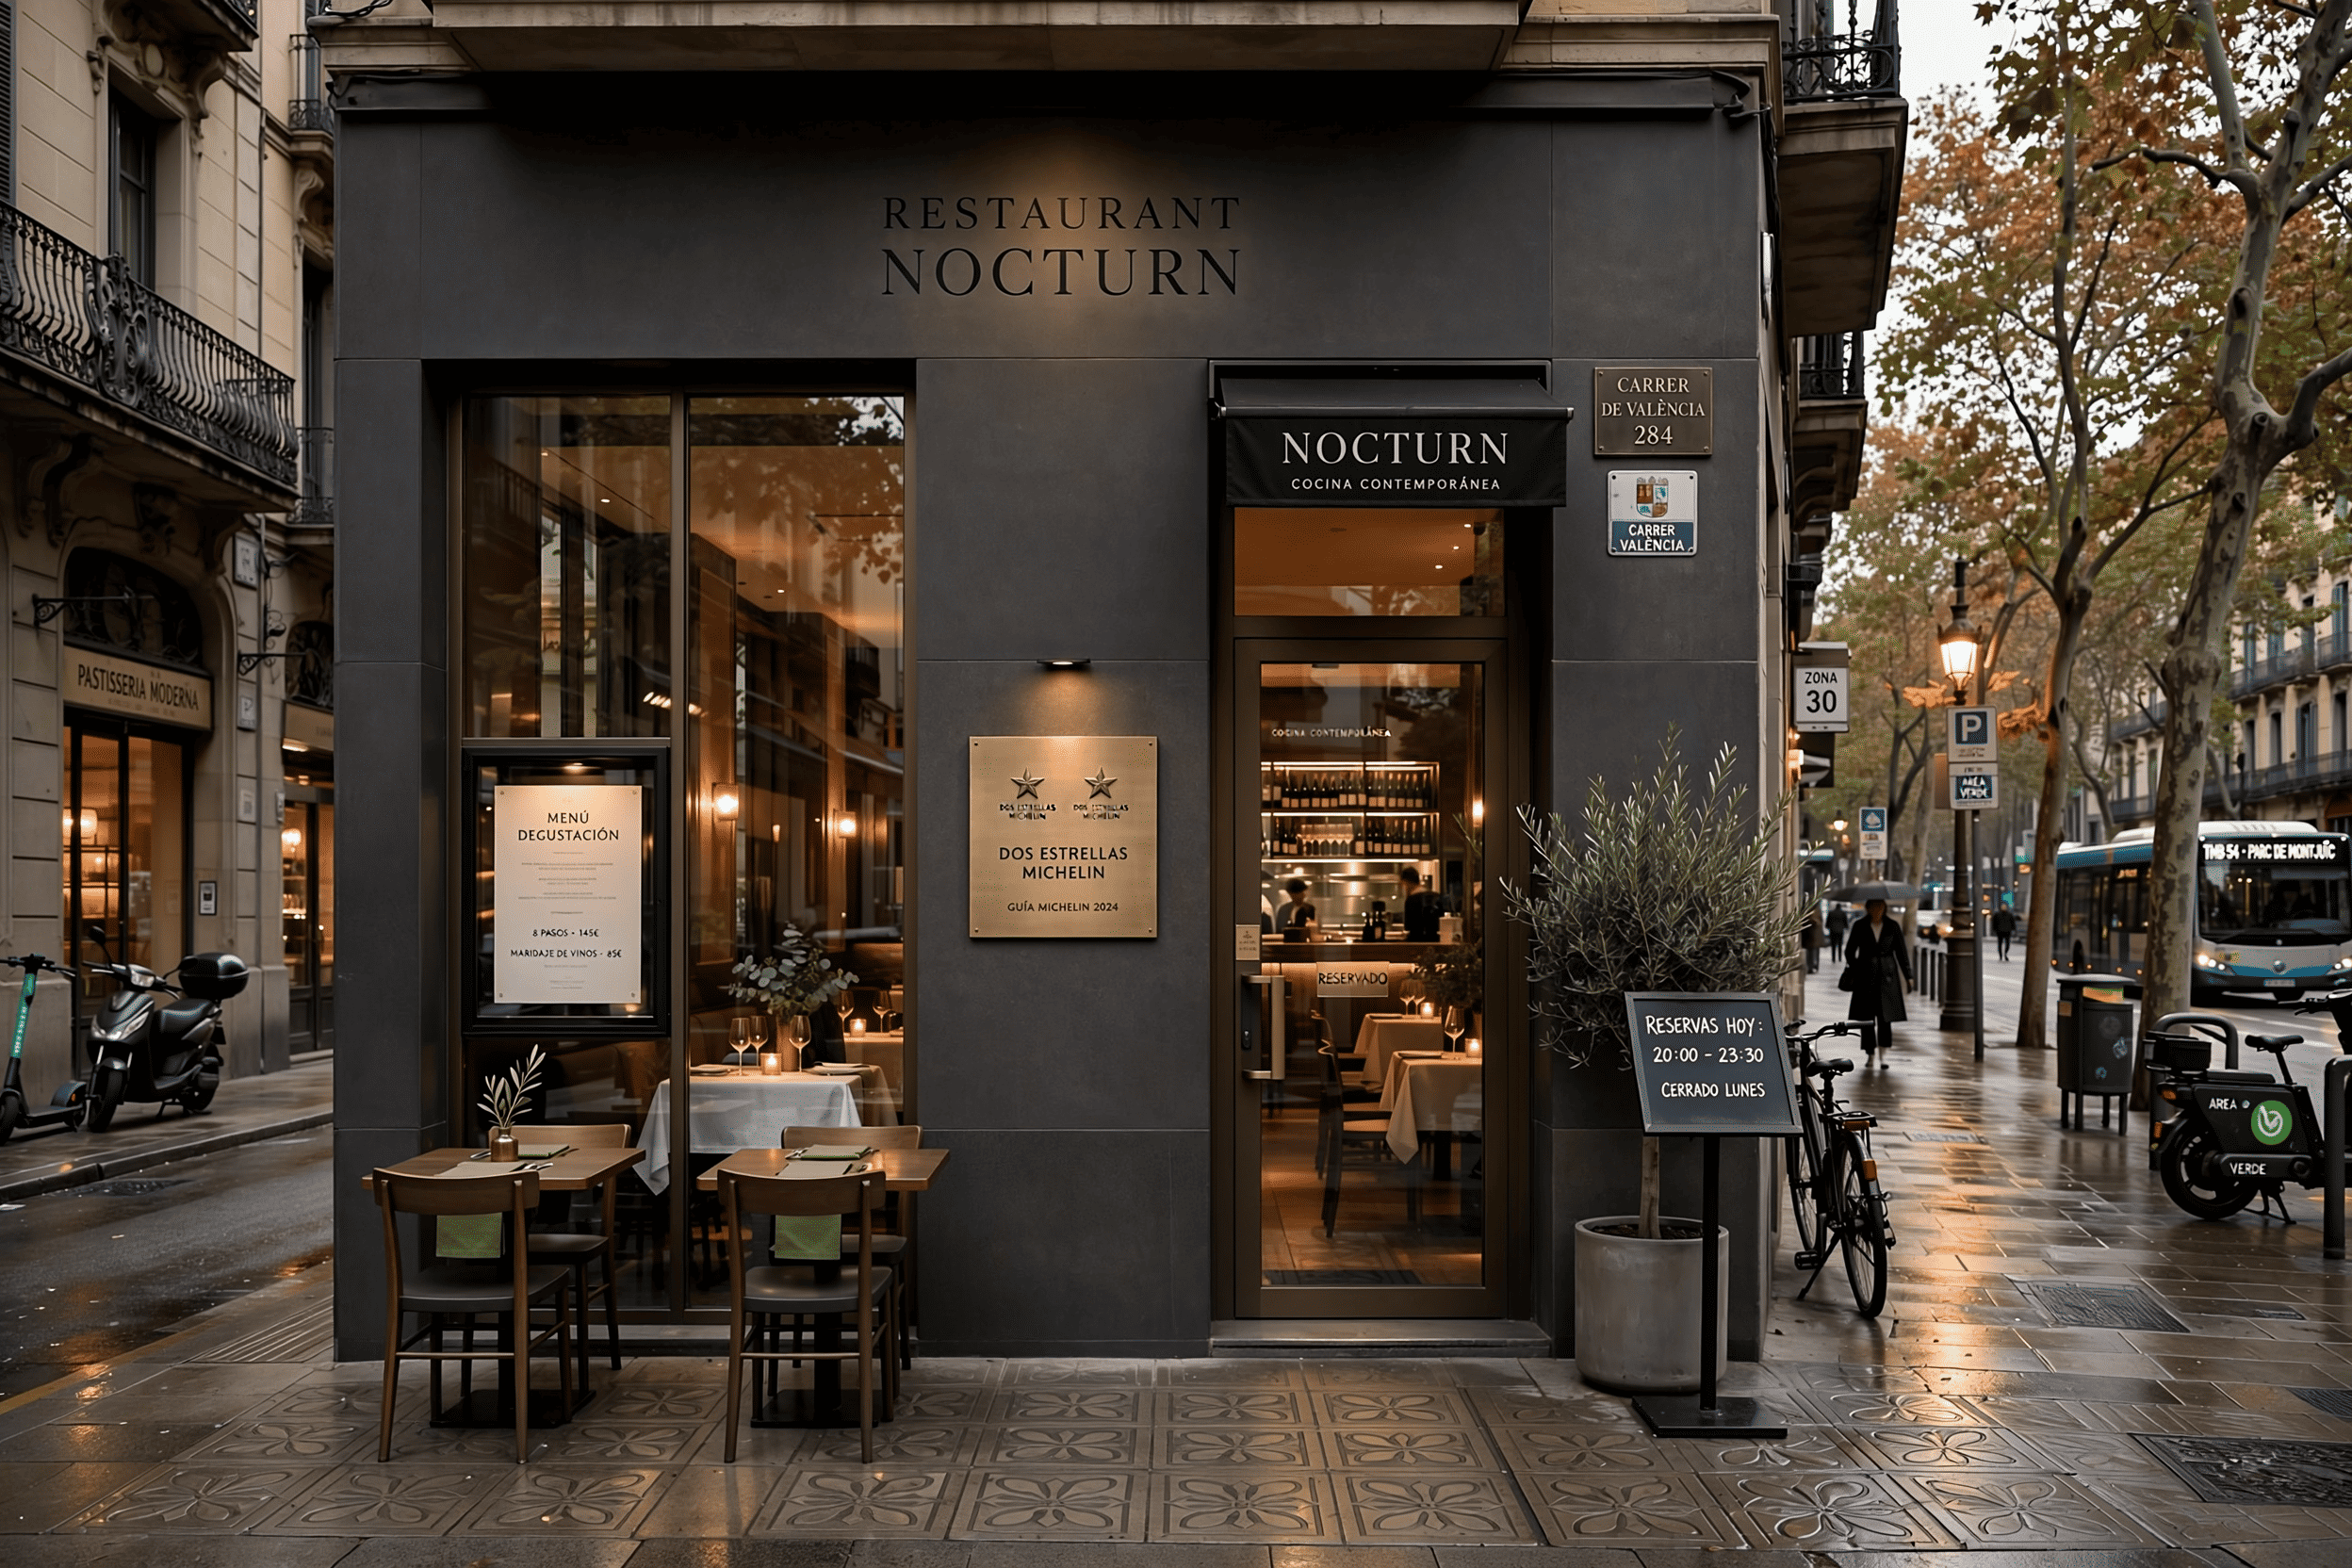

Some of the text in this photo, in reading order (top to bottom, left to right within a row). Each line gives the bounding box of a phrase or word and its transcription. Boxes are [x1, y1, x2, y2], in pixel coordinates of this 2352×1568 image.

[883, 196, 1241, 230] RESTAURANT
[881, 247, 1241, 297] NOCTURN
[1617, 377, 1690, 393] CARRER
[1601, 399, 1706, 416] DE VALÈNCIA
[1634, 425, 1674, 445] 284
[1282, 432, 1508, 465] NOCTURN
[1291, 476, 1500, 490] COCINA CONTEMPORÁNEA
[1628, 524, 1675, 536] CARRER
[1620, 534, 1685, 551] VALÈNCIA
[1805, 672, 1838, 684] ZONA
[78, 663, 147, 700] PASTISSERIA
[150, 680, 200, 711] MODERNA
[1806, 690, 1837, 713] 30
[1962, 714, 1982, 743] P
[547, 810, 590, 825] MENÚ
[517, 827, 620, 841] DEGUSTACIÓN
[999, 847, 1128, 860] DOS ESTRELLAS
[2274, 843, 2287, 859] DE
[1022, 866, 1105, 879] MICHELIN
[1007, 901, 1119, 912] GUÍA MICHELIN 2024
[532, 929, 539, 938] 8
[541, 928, 568, 938] PASOS
[580, 928, 599, 938] 145€
[510, 949, 554, 958] MARIDAJE
[557, 949, 568, 958] DE
[570, 949, 597, 958] VINOS
[1318, 972, 1388, 985] RESERVADO
[1645, 1015, 1719, 1035] RESERVAS
[1653, 1046, 1698, 1063] 20:00
[1718, 1047, 1764, 1064] 23:30
[1661, 1082, 1766, 1098] CERRADO LUNES
[2208, 1098, 2238, 1110] AREA
[2230, 1162, 2267, 1176] VERDE
